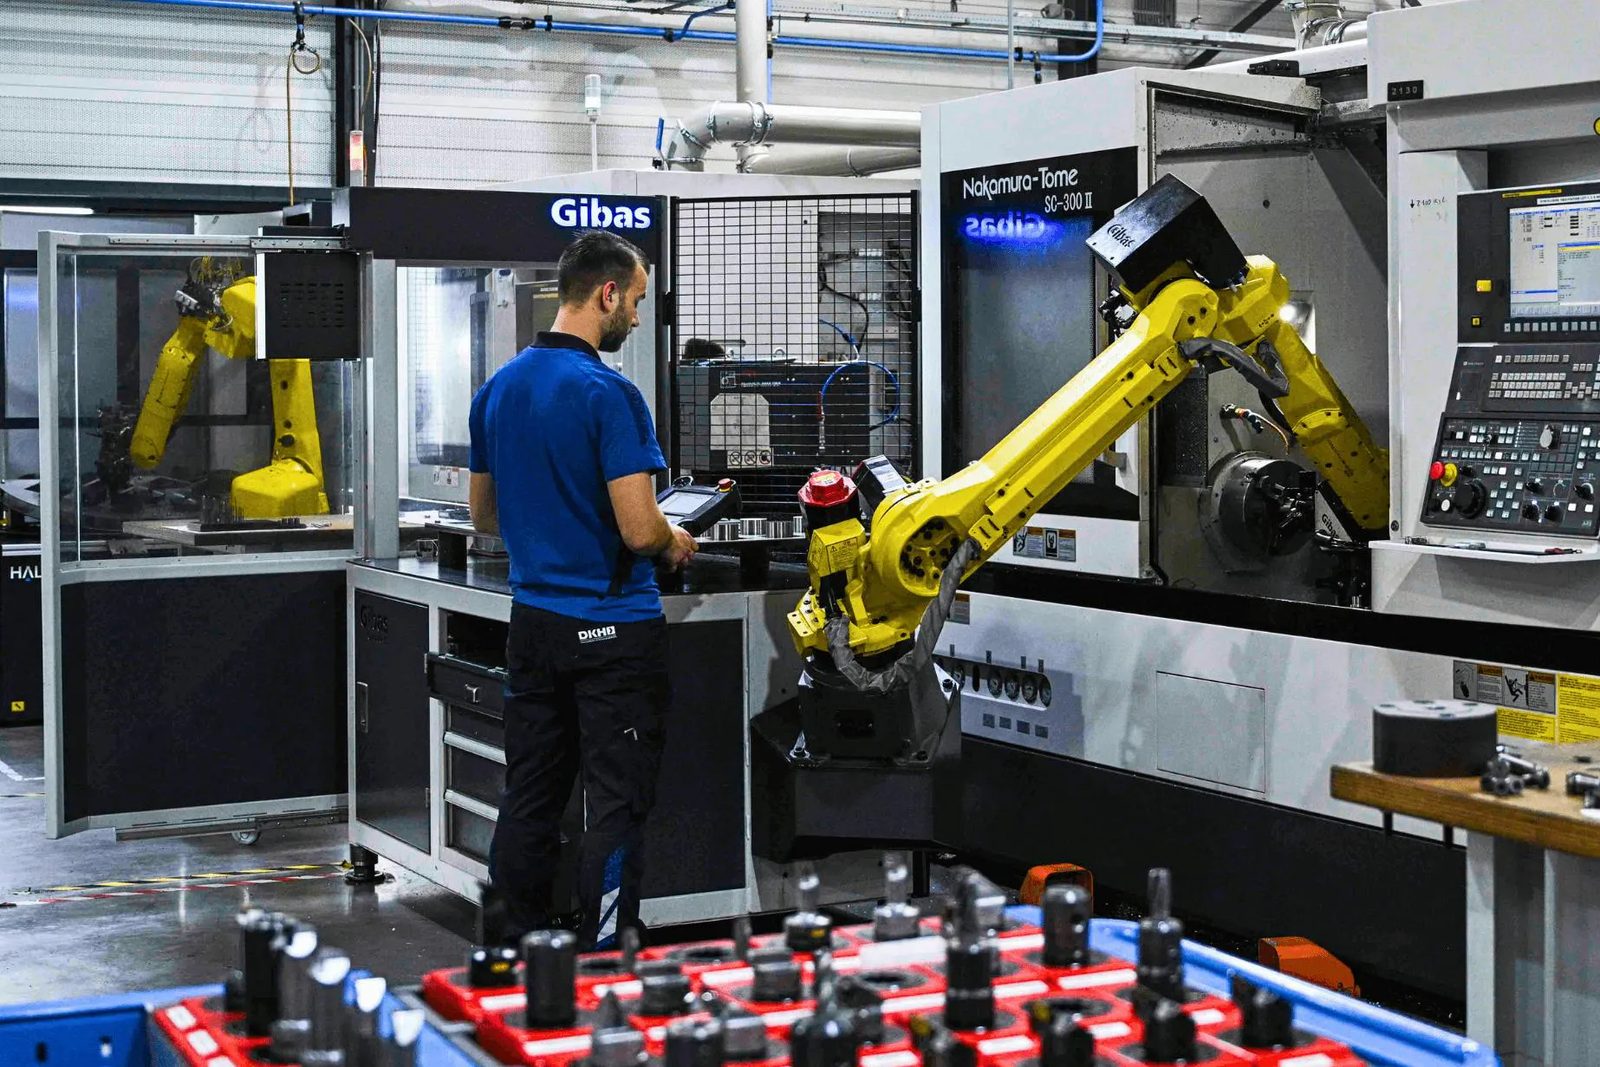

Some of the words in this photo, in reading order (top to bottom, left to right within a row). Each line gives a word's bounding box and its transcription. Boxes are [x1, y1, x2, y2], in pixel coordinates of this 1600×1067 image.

[1391, 85, 1418, 96] 2130
[963, 166, 1079, 200] Nakamura-Tome
[551, 197, 651, 229] Gibas
[1044, 192, 1083, 213] SC-300
